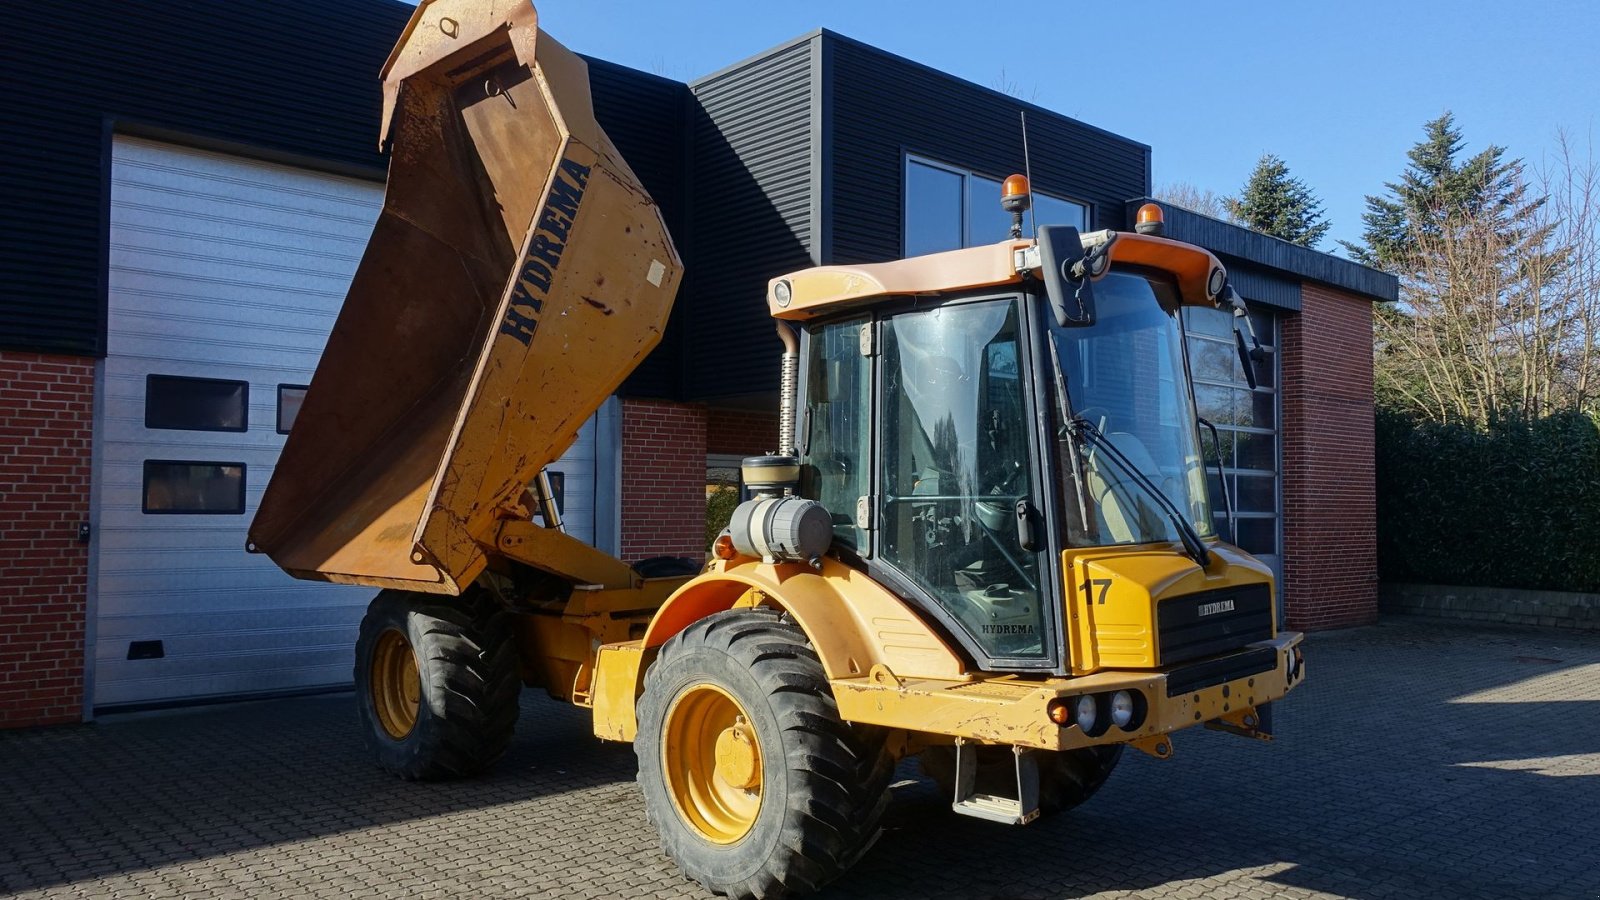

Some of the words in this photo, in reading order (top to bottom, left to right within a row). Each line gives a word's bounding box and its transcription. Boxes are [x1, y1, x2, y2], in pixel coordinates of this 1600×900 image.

[500, 158, 592, 347] HYDREMA
[1079, 579, 1112, 605] 17
[1203, 599, 1235, 615] HYDREMA
[981, 624, 1034, 634] HYDREMA
